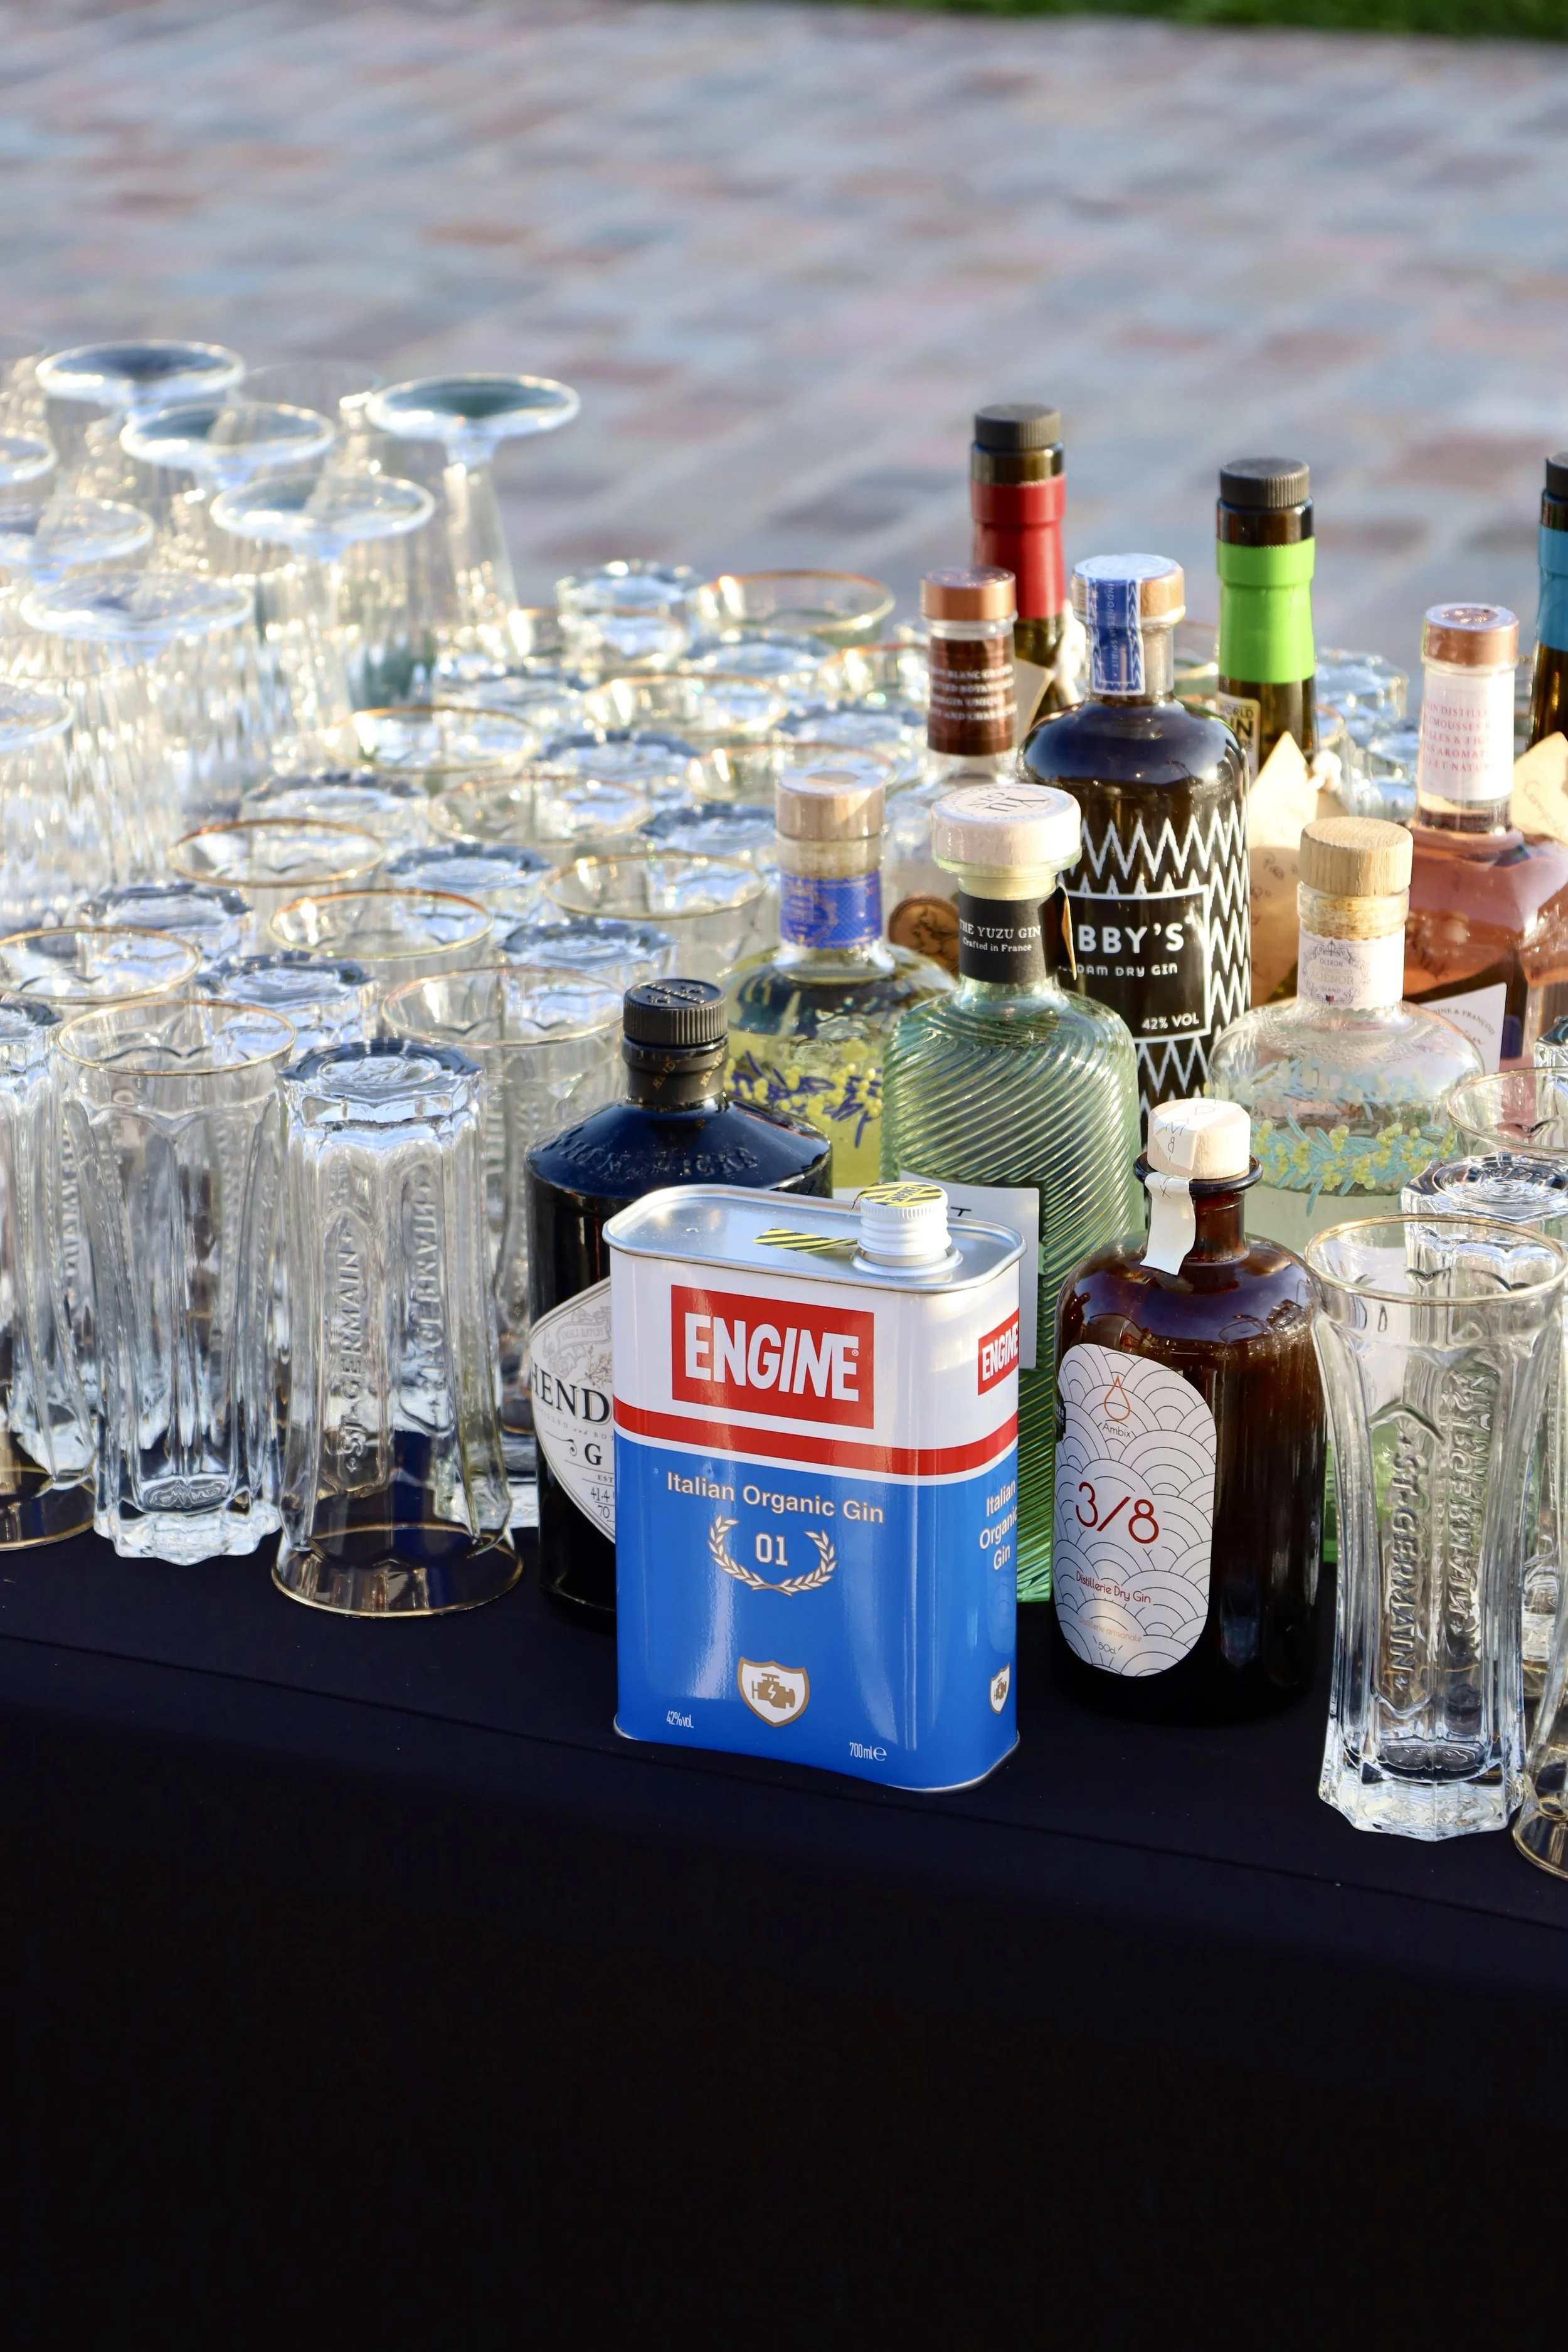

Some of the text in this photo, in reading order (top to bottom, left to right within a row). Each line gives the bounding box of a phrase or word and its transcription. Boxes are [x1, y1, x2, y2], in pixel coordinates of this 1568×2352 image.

[960, 919, 1041, 940] THE YUZU GIN
[963, 936, 1032, 953] Crafted in France
[1078, 923, 1184, 954] BBY'S
[1141, 1012, 1199, 1030] 42% VOL
[581, 1327, 603, 1337] BATCH
[685, 1312, 859, 1402] ENGINE
[982, 1320, 1019, 1381] ENGINE
[1101, 1422, 1131, 1439] Ambix
[598, 1505, 610, 1518] 70
[667, 1471, 884, 1524] Italian Organic Gin
[986, 1480, 1016, 1517] Italian
[1075, 1481, 1160, 1544] 3/8
[979, 1506, 1018, 1550] Organic
[755, 1532, 789, 1567] 01
[993, 1544, 1010, 1571] Gin
[1076, 1571, 1152, 1604] Distillerie Dry Gin
[1106, 1628, 1143, 1643] artisanale
